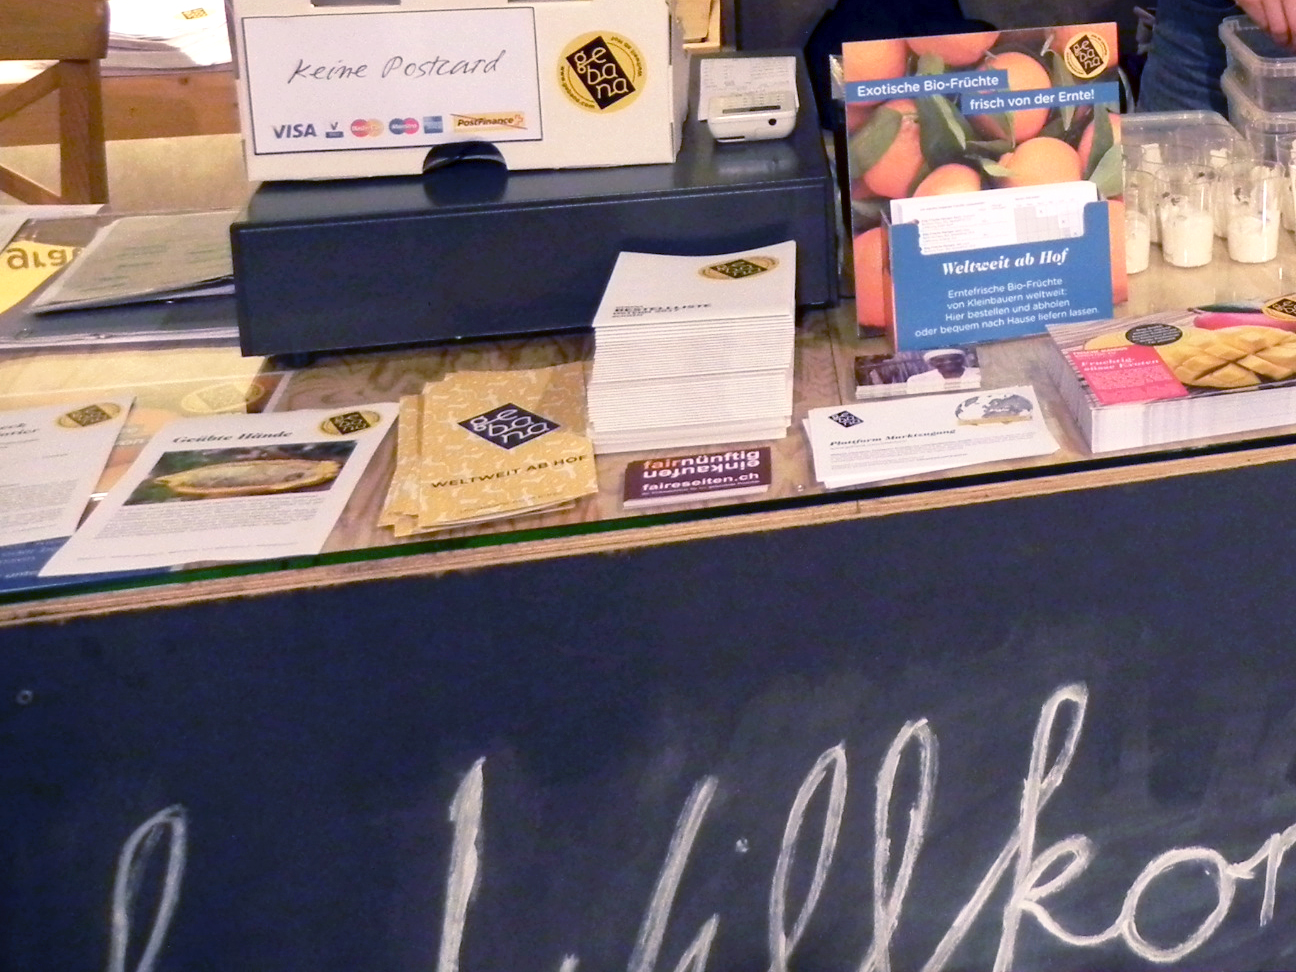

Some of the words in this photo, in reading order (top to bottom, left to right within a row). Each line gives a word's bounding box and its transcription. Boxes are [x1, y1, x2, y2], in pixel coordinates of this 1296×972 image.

[381, 49, 507, 79] Postcard
[857, 82, 921, 98] Exotische
[923, 75, 1000, 92] Bio-Früchte
[970, 97, 1005, 111] frisch
[1008, 97, 1032, 108] von
[1034, 93, 1055, 105] der
[1058, 88, 1095, 103] Ernte!
[272, 122, 318, 140] VISA
[942, 257, 1010, 277] Weltweit
[1014, 254, 1035, 267] ab
[1039, 246, 1070, 266] Hof
[948, 286, 1005, 299] Erntefrische
[1007, 277, 1063, 292] Bio-Früchte
[945, 311, 965, 322] Hier
[967, 306, 1010, 319] bestellen
[1012, 302, 1031, 314] und
[1033, 299, 1070, 312] abholen
[947, 302, 965, 310] von
[967, 292, 1023, 307] Kleinbauern
[914, 327, 938, 338] oder
[940, 322, 980, 337] bequem
[981, 317, 1005, 329] nach
[1006, 312, 1036, 325] Hause
[1037, 307, 1068, 321] liefern
[173, 433, 233, 443] Geübte
[238, 430, 293, 440] Hände
[431, 468, 520, 488] WELTWEIT
[526, 462, 548, 471] AB
[554, 454, 587, 466] HOF
[643, 450, 760, 470] fairnünftig
[642, 472, 760, 491] faireseiten.ch
